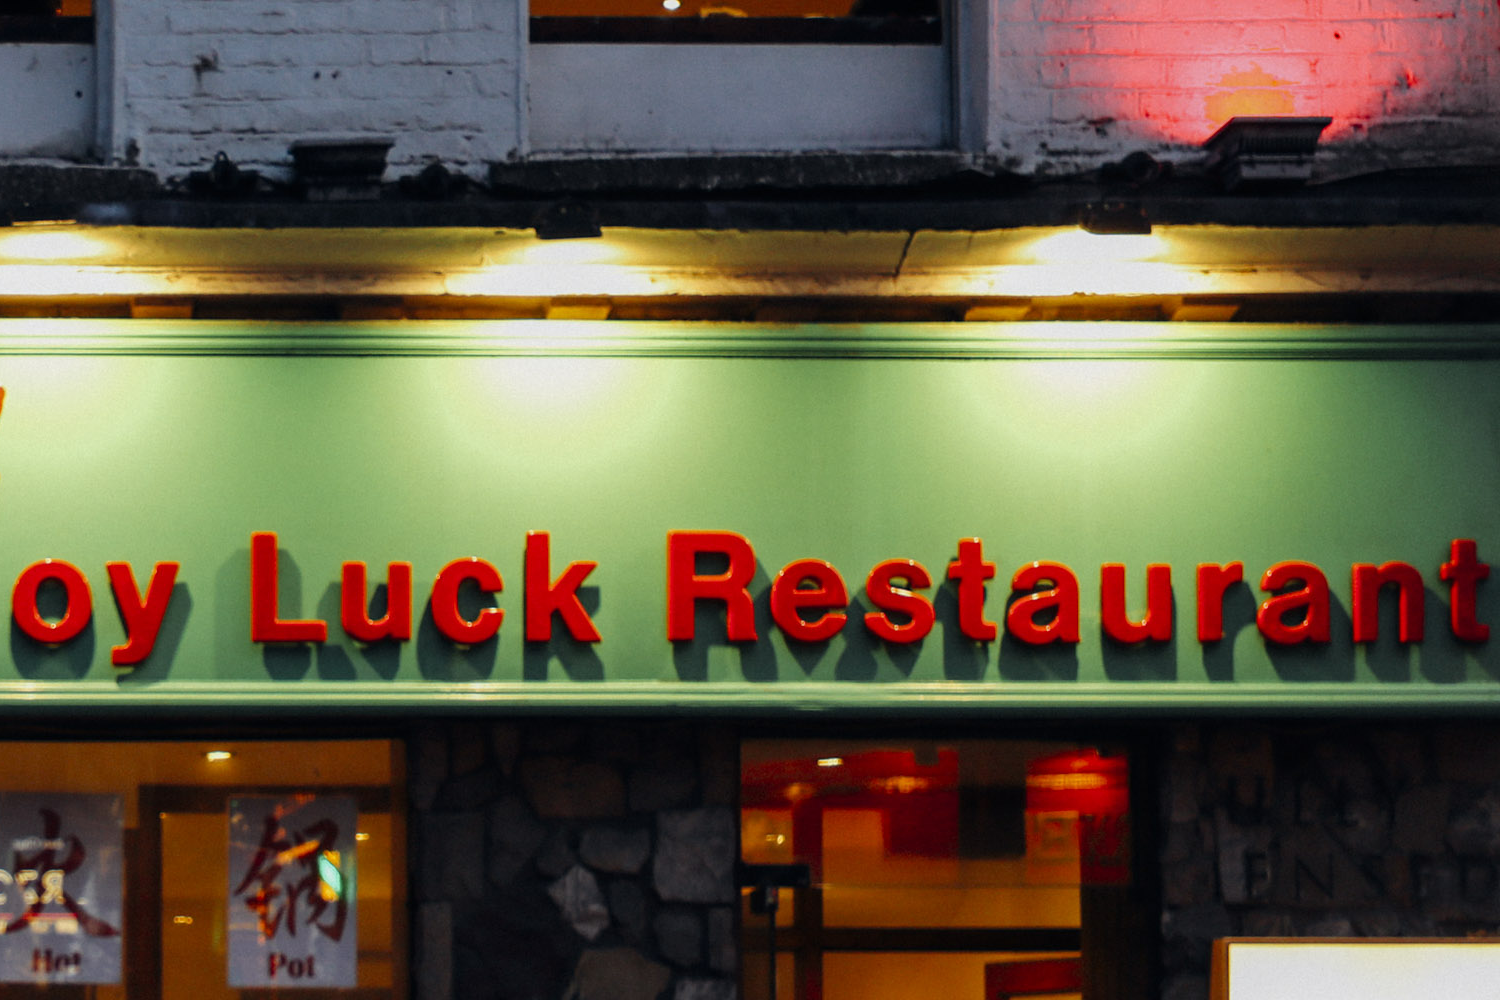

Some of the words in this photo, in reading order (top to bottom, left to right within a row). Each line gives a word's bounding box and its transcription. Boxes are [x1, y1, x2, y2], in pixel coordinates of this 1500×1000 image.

[250, 530, 603, 644] Luck
[665, 528, 1492, 646] Restaurant
[266, 951, 316, 979] Pot
